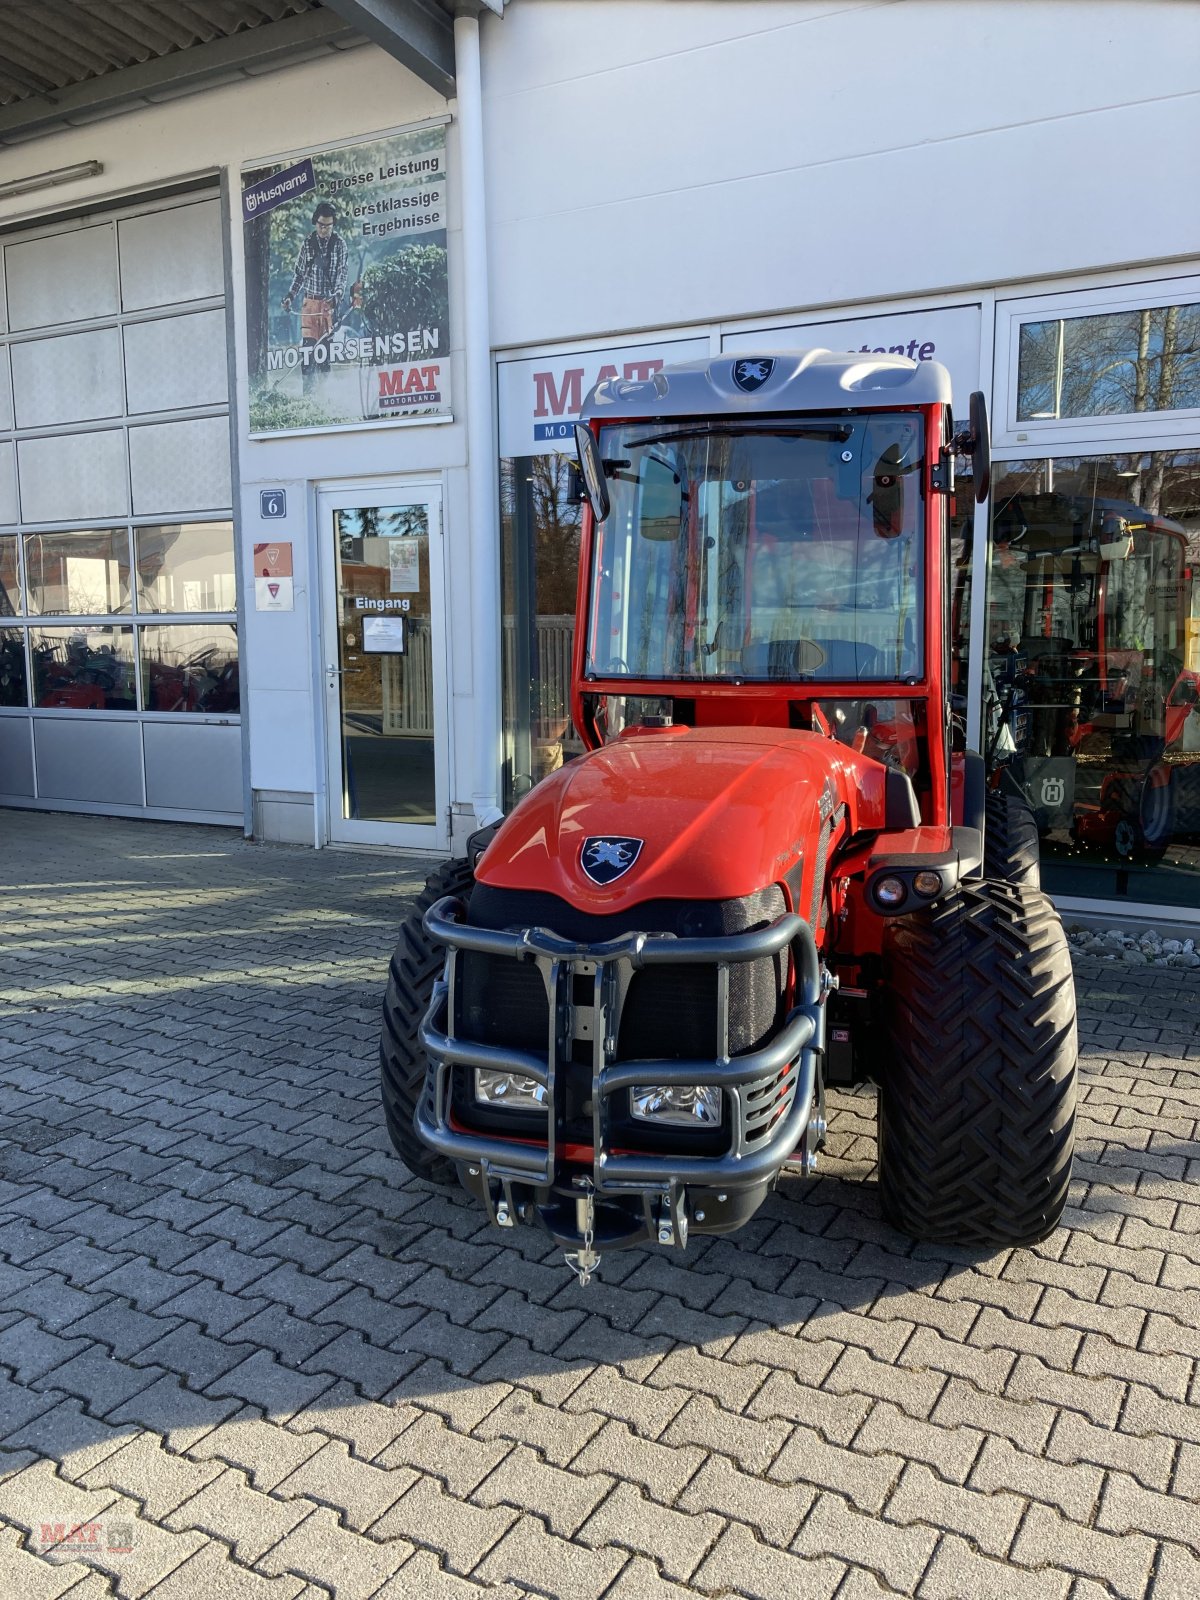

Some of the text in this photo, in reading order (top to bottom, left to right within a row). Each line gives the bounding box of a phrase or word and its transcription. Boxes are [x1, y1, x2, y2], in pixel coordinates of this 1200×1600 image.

[256, 172, 308, 205] Husqvarna
[330, 157, 439, 194] grosse Leistung
[353, 191, 440, 217] erstklassige
[362, 212, 440, 236] Ergebnisse
[267, 328, 439, 371] MOTORSENSEN
[378, 365, 440, 397] MAT
[384, 394, 435, 406] MOTORLAND
[268, 497, 278, 514] 6
[355, 597, 410, 611] Eingang
